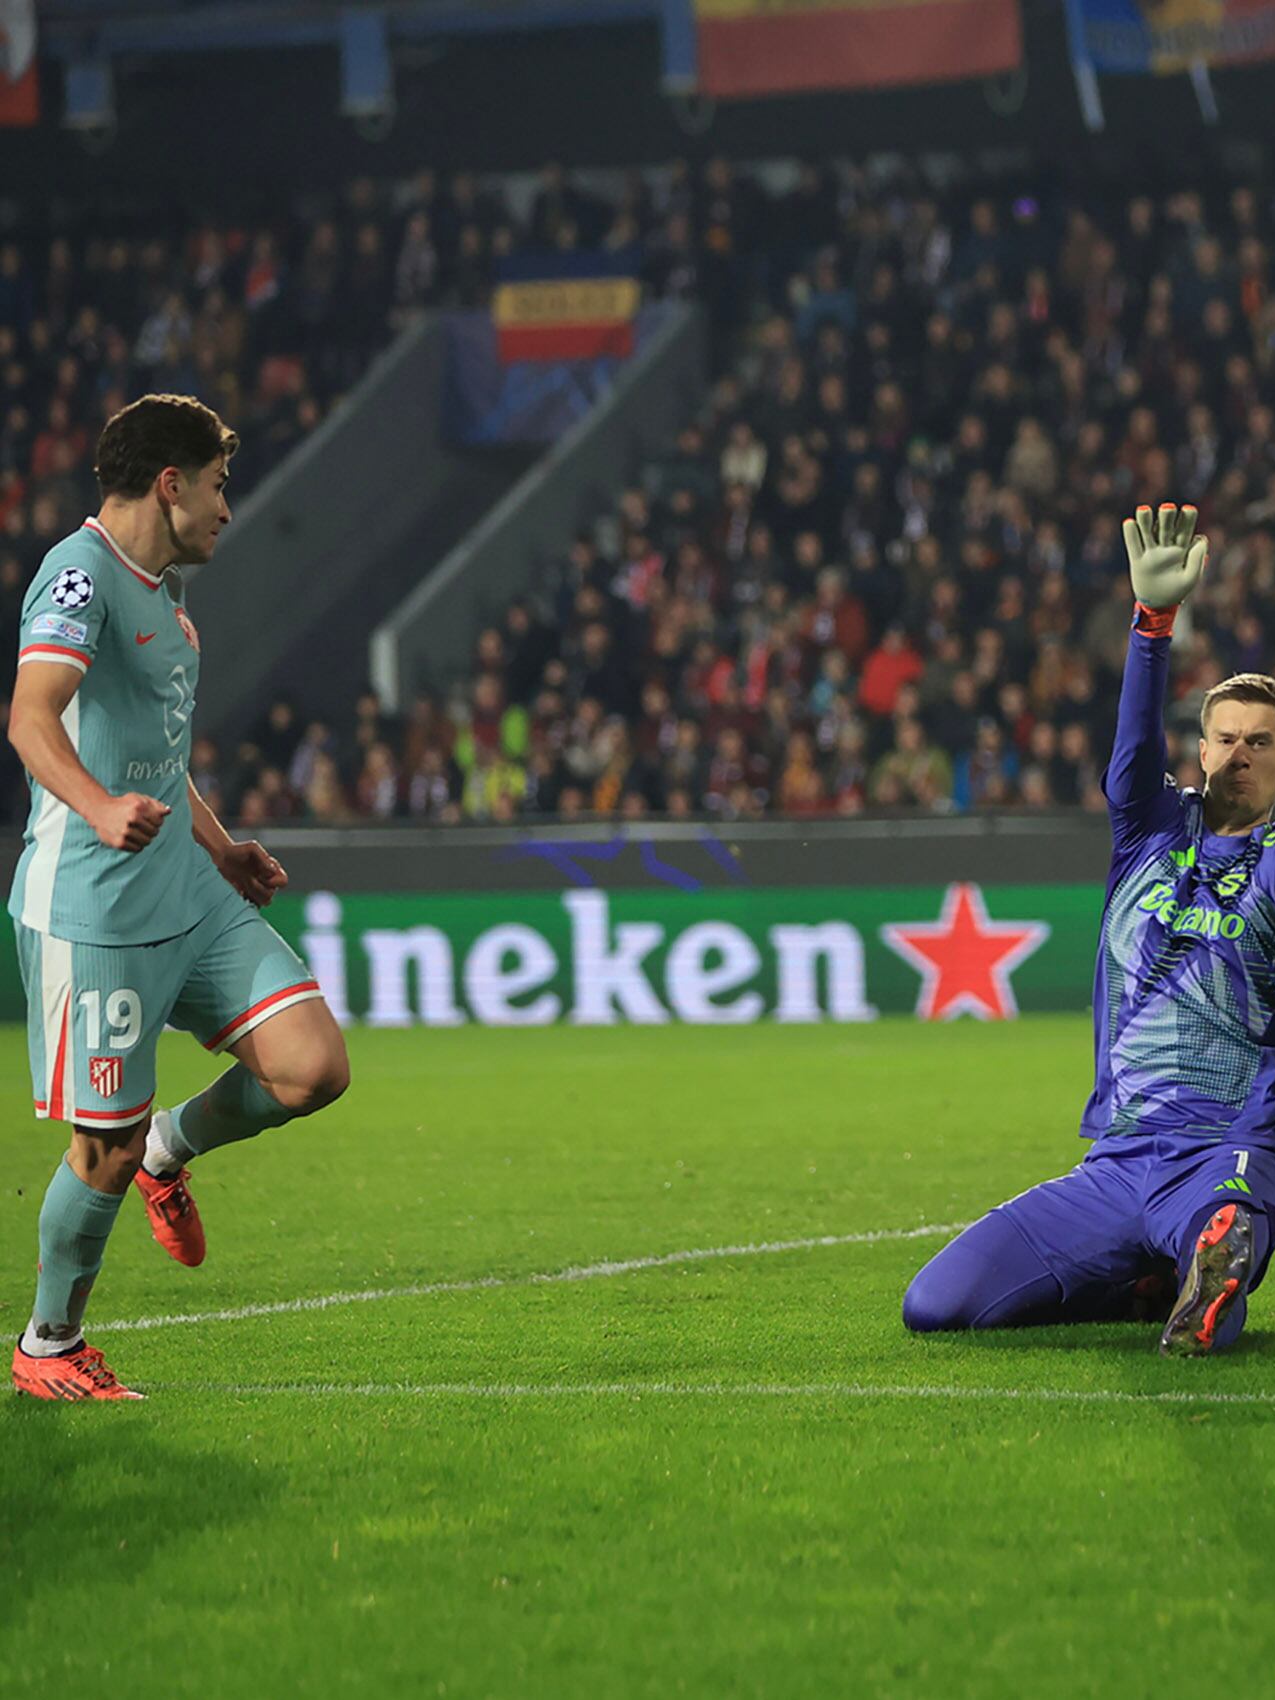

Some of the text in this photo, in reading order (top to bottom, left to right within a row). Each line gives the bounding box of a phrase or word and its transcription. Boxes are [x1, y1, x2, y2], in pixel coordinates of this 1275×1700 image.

[126, 752, 185, 780] RIYADH
[1140, 882, 1247, 939] Betano
[301, 888, 878, 1026] ineken
[78, 988, 142, 1050] 19
[1233, 1150, 1249, 1176] 1
